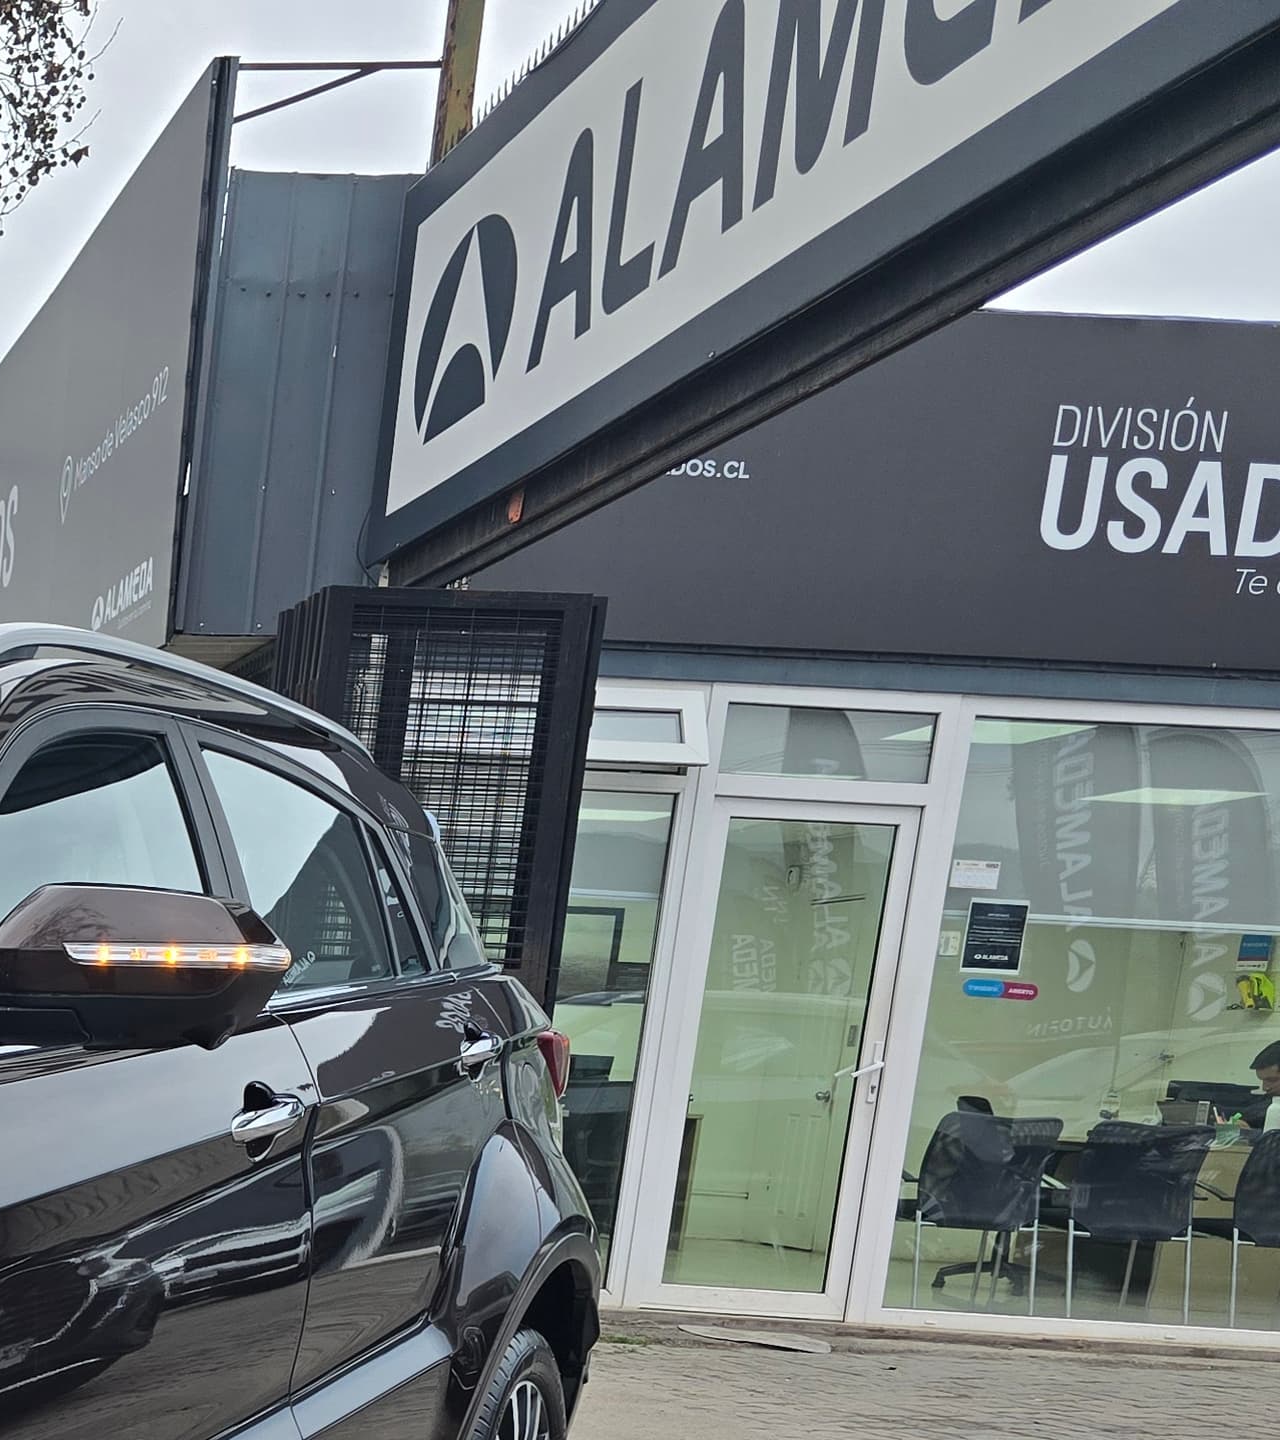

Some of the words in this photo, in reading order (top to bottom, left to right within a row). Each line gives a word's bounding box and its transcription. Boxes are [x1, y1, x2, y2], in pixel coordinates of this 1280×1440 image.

[526, 0, 1054, 375] ALAM
[101, 428, 114, 463] de
[151, 366, 169, 412] 912
[1052, 397, 1228, 453] DIVISIÓN
[103, 556, 153, 624] ALAMEDA
[1236, 569, 1268, 595] Te
